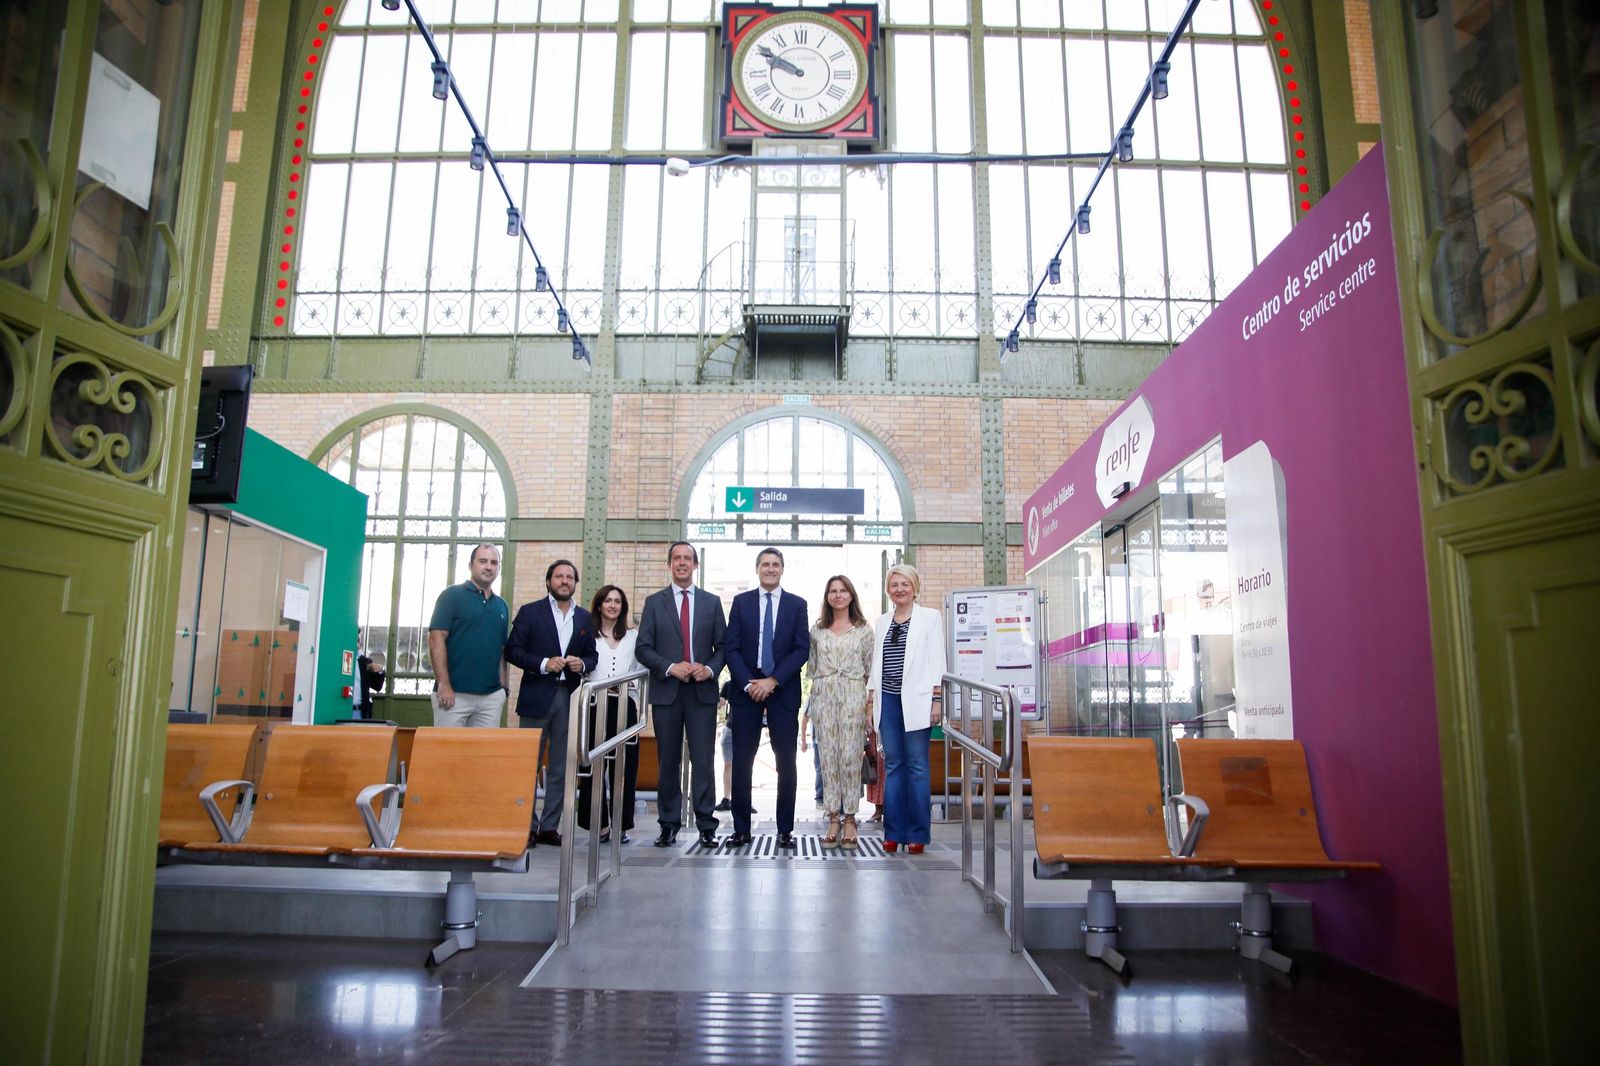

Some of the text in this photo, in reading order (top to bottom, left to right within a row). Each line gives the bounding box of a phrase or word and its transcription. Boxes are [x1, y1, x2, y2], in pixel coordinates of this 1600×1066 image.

[794, 30, 808, 44] XII
[829, 50, 846, 62] II
[834, 70, 851, 80] III
[1242, 211, 1372, 341] Centro de servicios
[1299, 257, 1377, 332] Service centre
[1105, 423, 1141, 477] renfe
[760, 491, 787, 502] Salida
[699, 526, 725, 534] SALIDA
[866, 528, 891, 536] SALIDA
[1238, 568, 1272, 595] Horario
[1240, 620, 1255, 633] Centro
[1256, 618, 1263, 629] de
[1243, 703, 1285, 718] Venta anticipada
